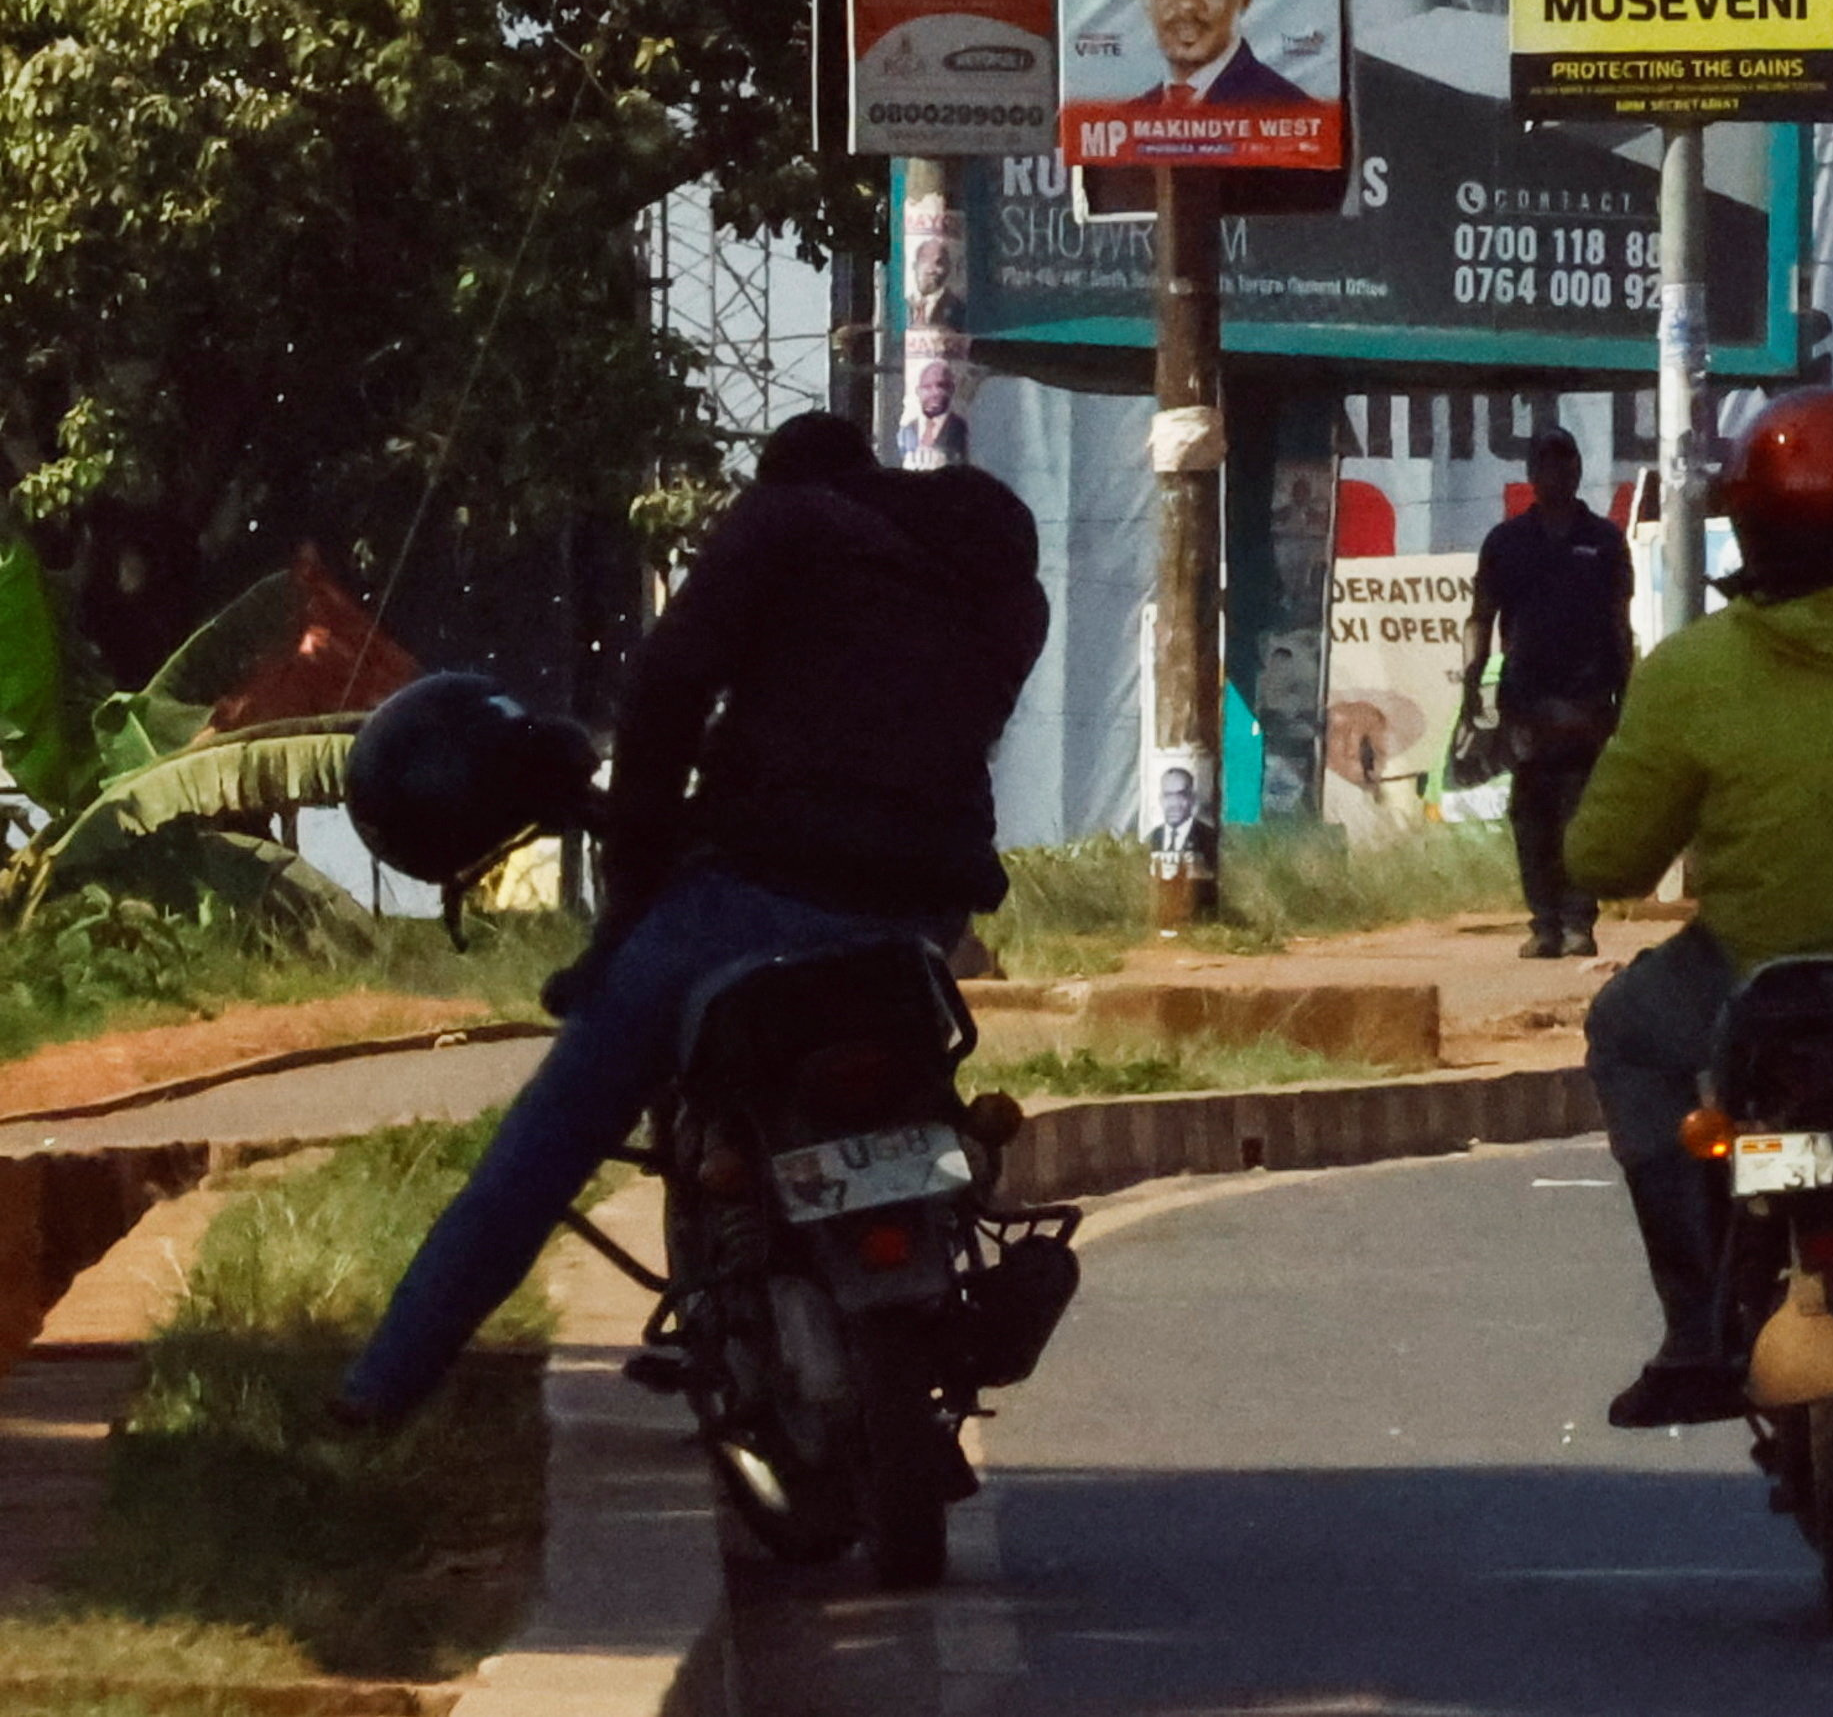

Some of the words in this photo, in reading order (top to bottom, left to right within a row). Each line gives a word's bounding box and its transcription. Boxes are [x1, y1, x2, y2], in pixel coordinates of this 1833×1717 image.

[1552, 61, 1684, 80] PROTECTING
[1691, 59, 1732, 78] THE
[1739, 59, 1803, 77] GAINS
[1080, 121, 1127, 157] MP
[1134, 119, 1250, 138] MAKINDYE
[1259, 119, 1322, 136] WEST
[1495, 188, 1631, 213] CONTACT
[1001, 205, 1247, 262] SHOWRM
[1455, 223, 1537, 262] 0700
[1553, 229, 1605, 265] 118
[1626, 231, 1662, 268] 88
[1454, 265, 1536, 304] 0764
[1551, 269, 1612, 307] 000
[1625, 273, 1662, 310] 92
[1331, 577, 1476, 604] DERATION
[1380, 617, 1463, 643] OPER
